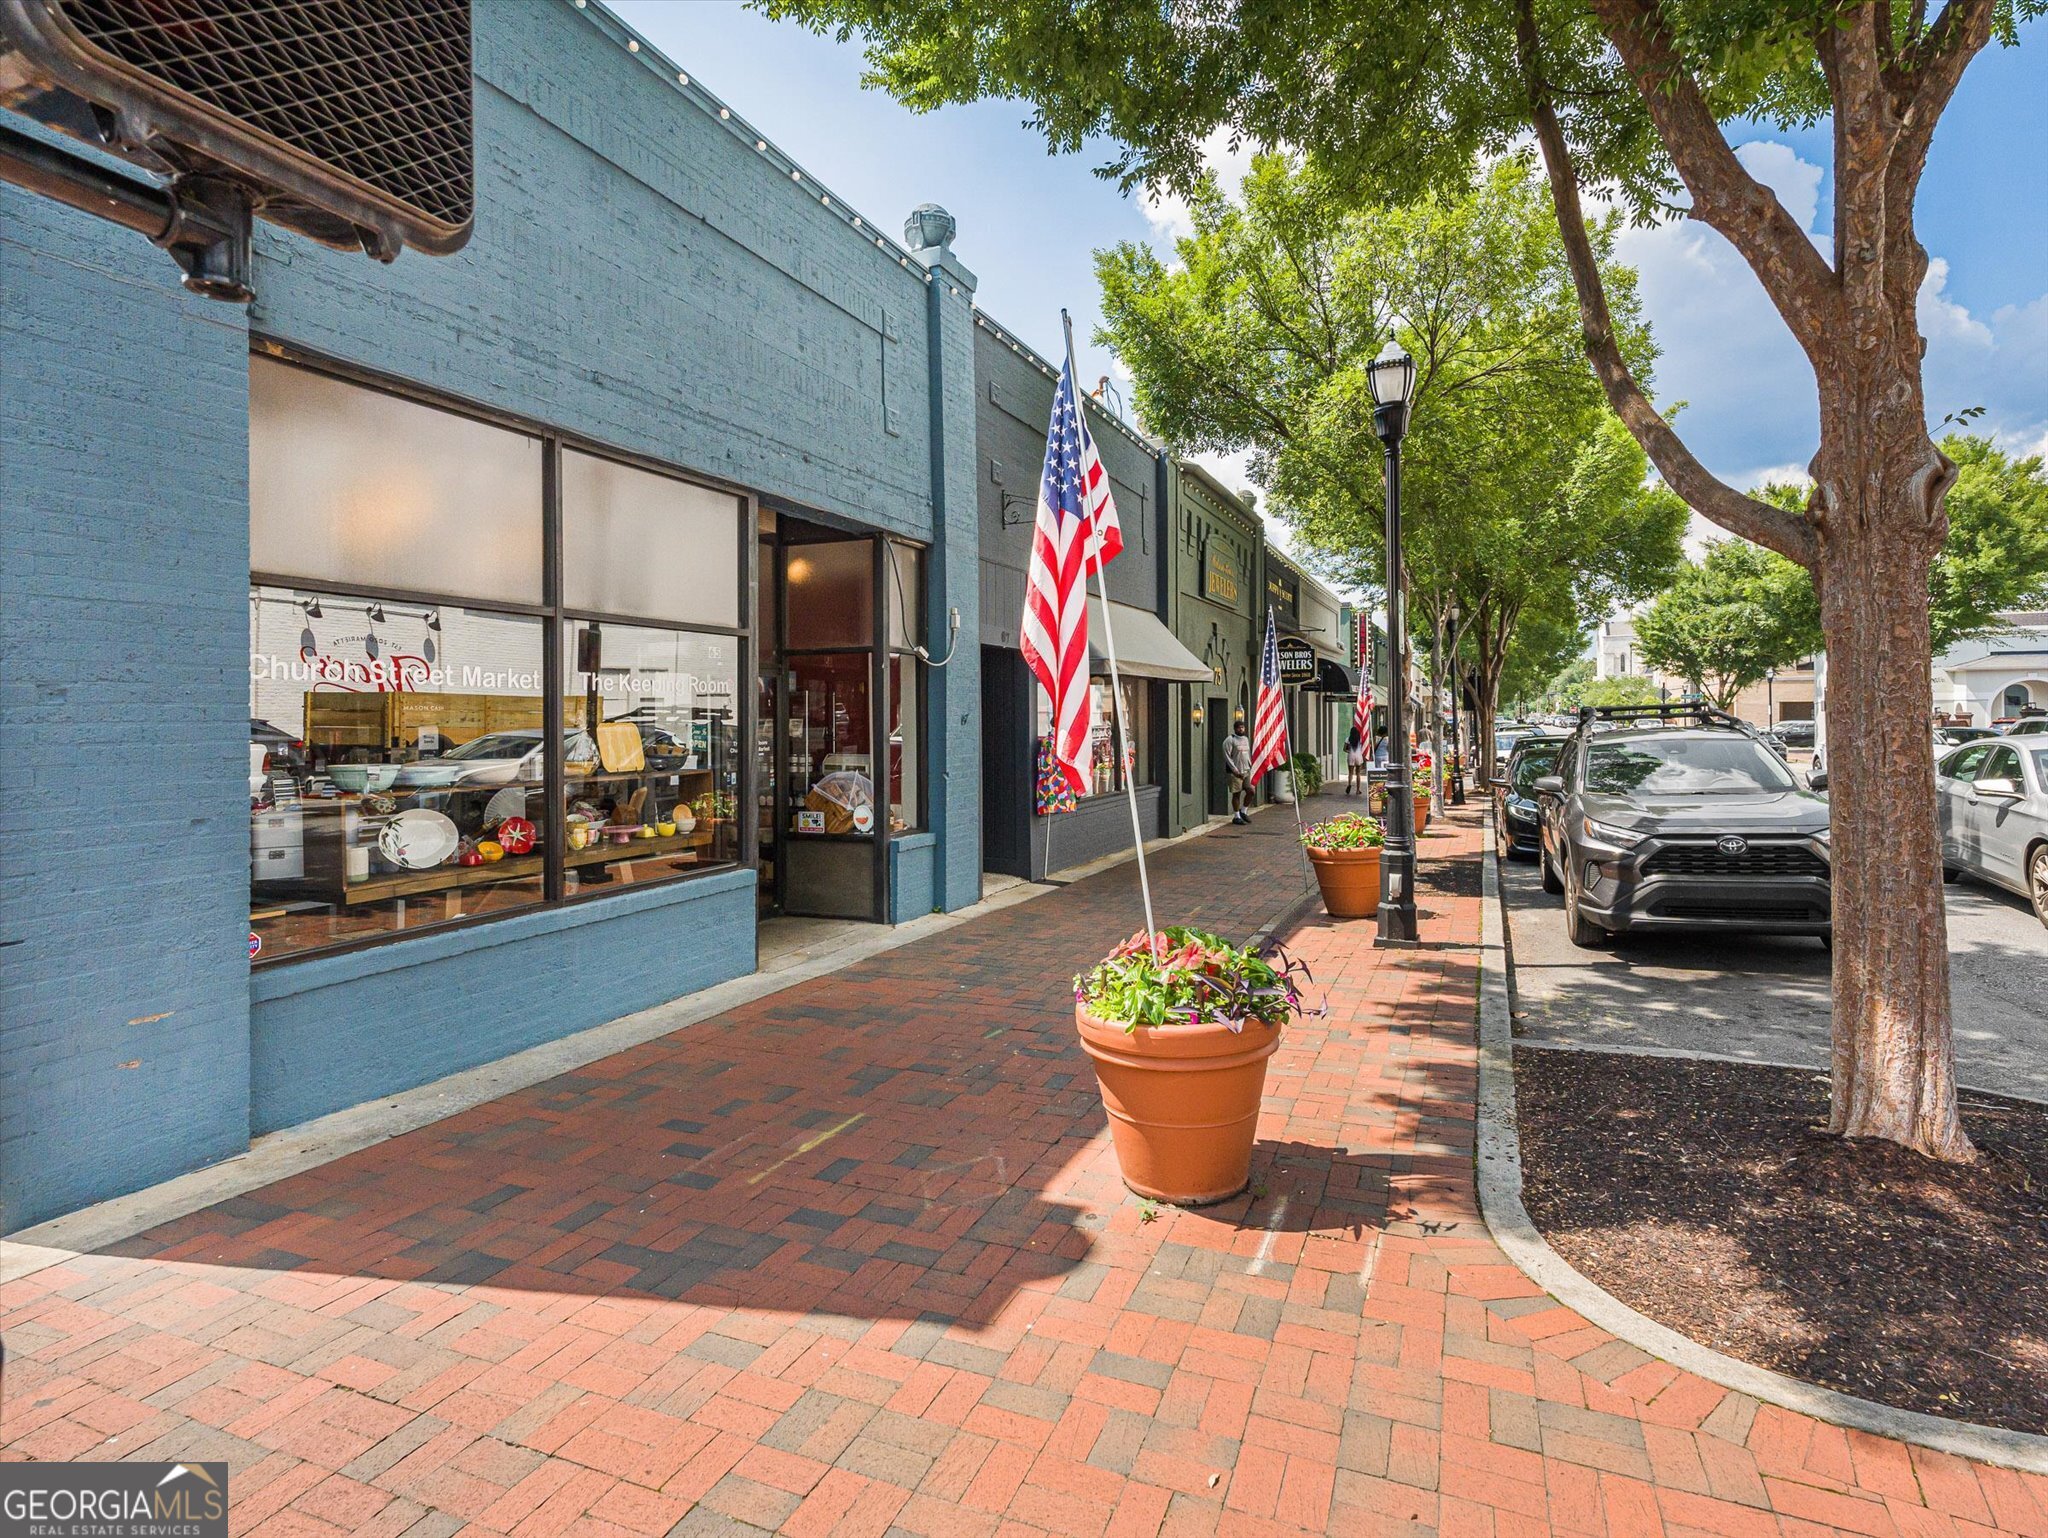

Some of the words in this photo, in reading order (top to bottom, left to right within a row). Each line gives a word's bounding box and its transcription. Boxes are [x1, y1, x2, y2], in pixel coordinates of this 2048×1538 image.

[1294, 651, 1312, 659] BROS
[250, 653, 361, 683] Church
[369, 658, 455, 687] Street
[462, 665, 541, 690] Market
[578, 672, 614, 692] The
[619, 673, 685, 696] Keeping
[689, 675, 729, 694] Room
